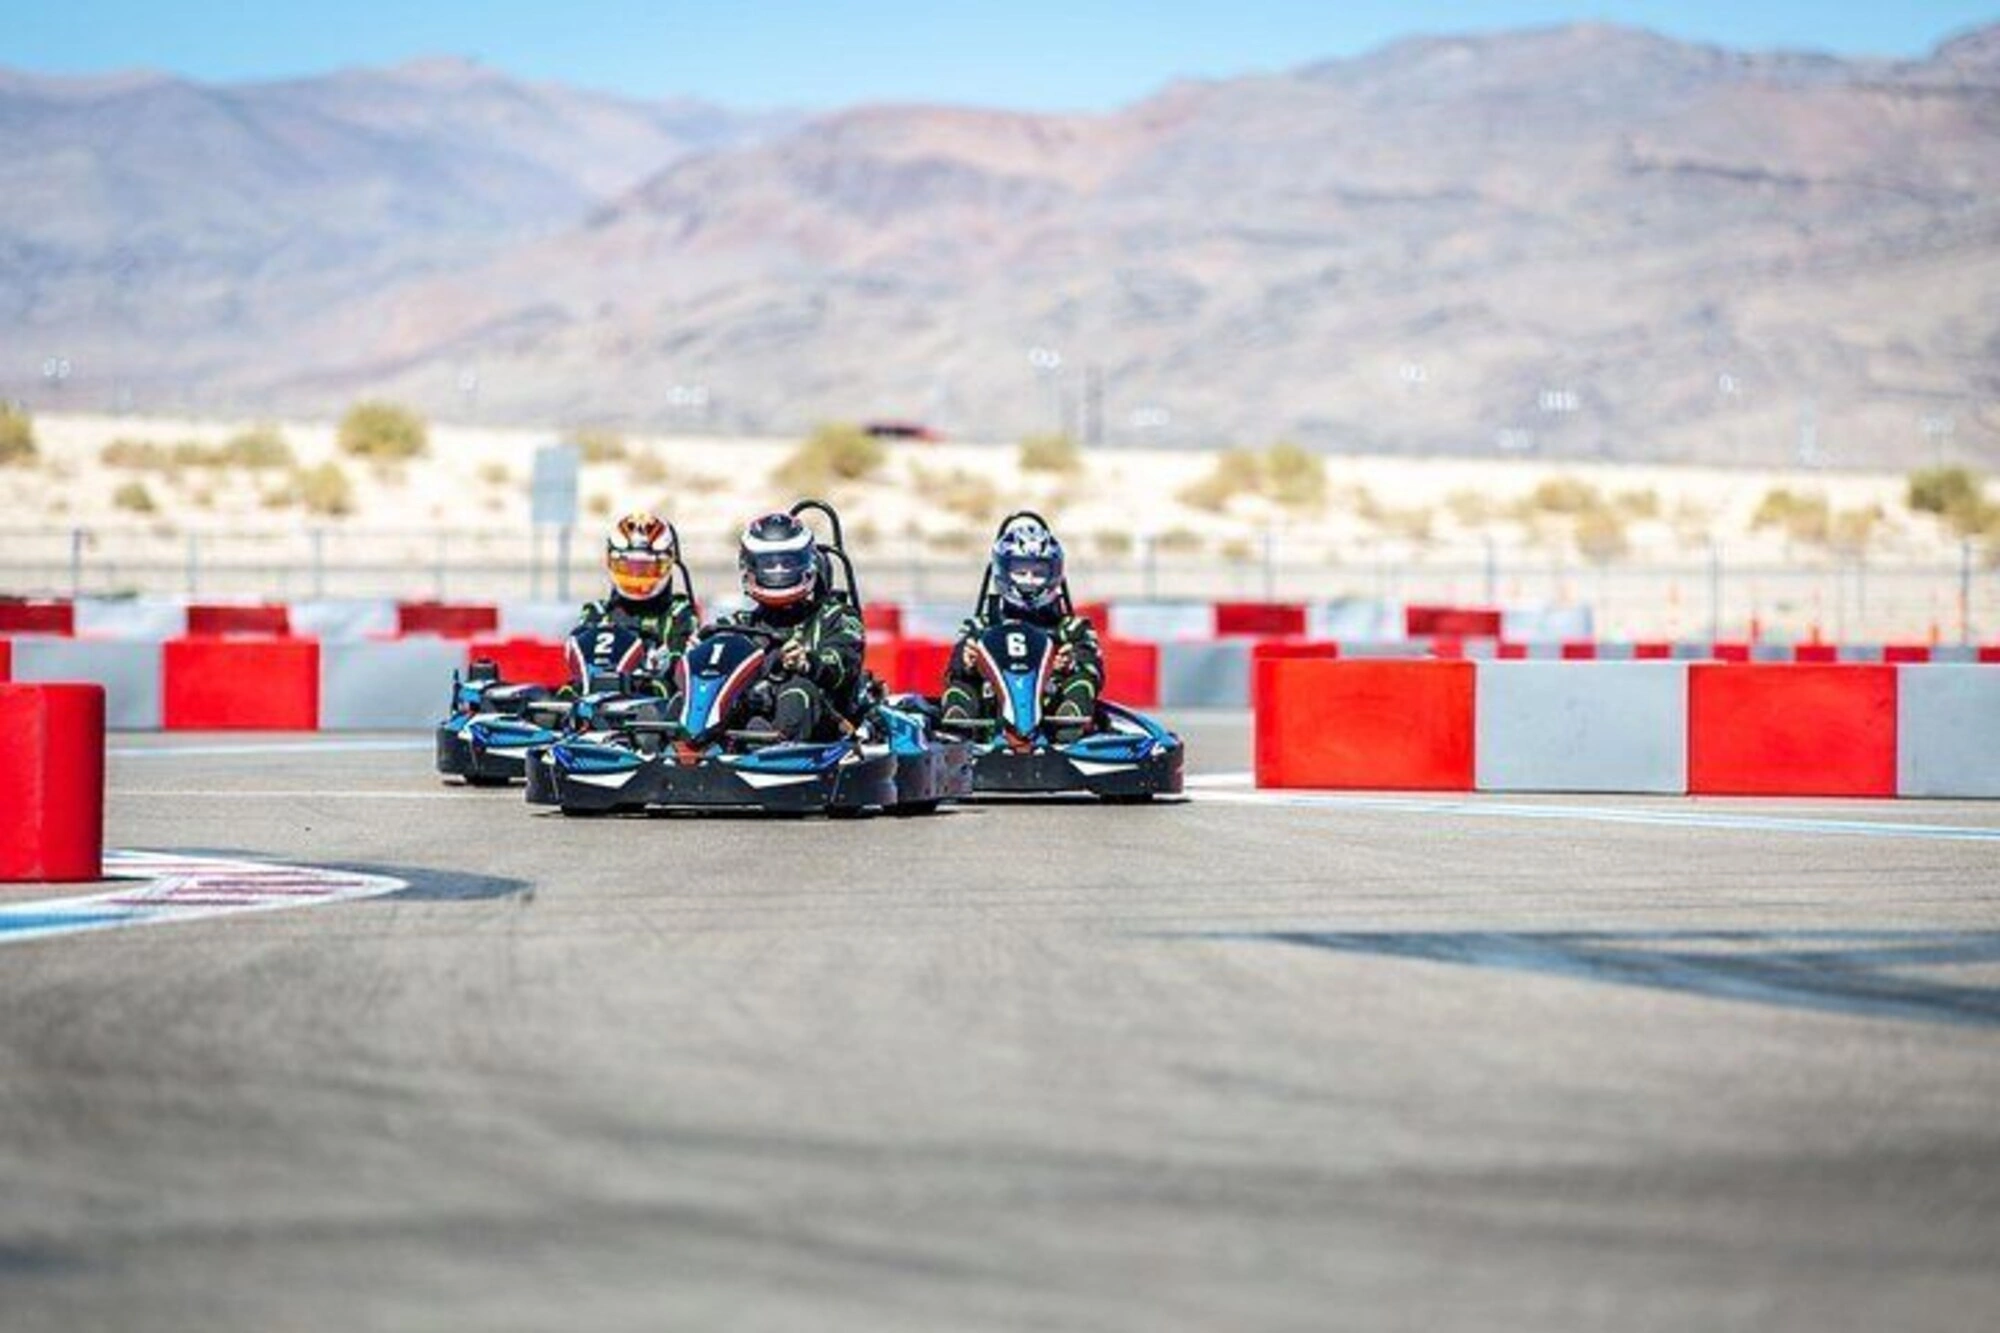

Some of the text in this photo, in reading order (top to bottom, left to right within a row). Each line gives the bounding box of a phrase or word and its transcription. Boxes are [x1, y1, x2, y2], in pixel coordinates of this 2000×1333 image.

[594, 633, 615, 653] 2
[709, 643, 725, 665] 1
[1006, 632, 1027, 657] 6
